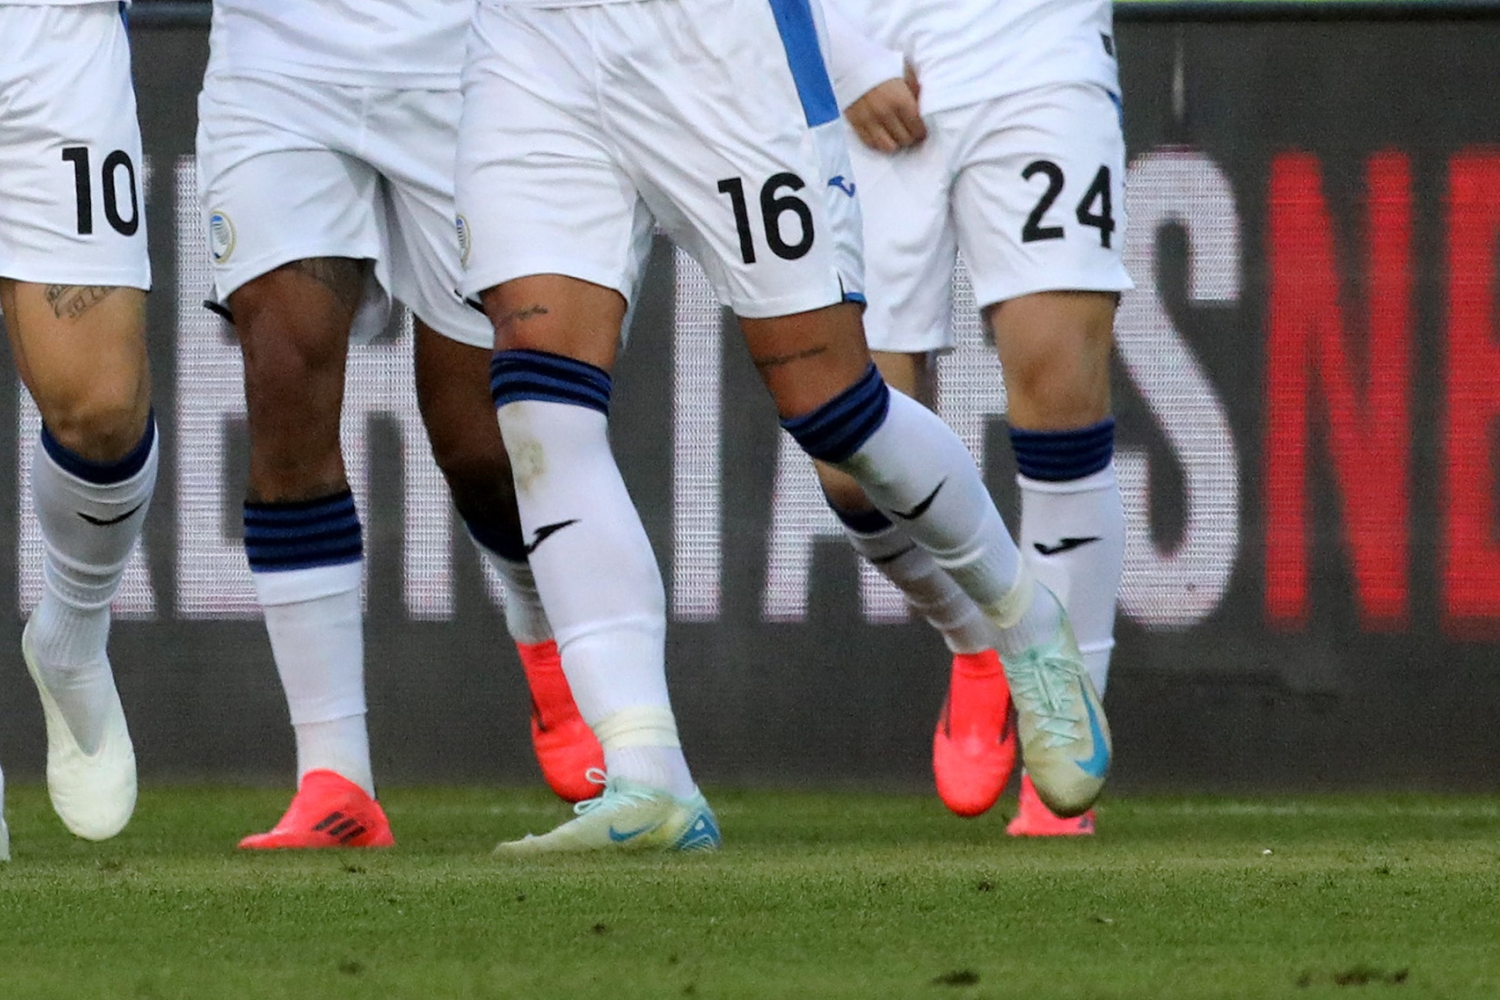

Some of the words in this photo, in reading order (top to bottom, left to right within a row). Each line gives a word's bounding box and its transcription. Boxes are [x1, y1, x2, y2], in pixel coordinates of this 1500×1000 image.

[62, 146, 139, 237] 10
[717, 172, 815, 264] 16
[1020, 159, 1115, 249] 24
